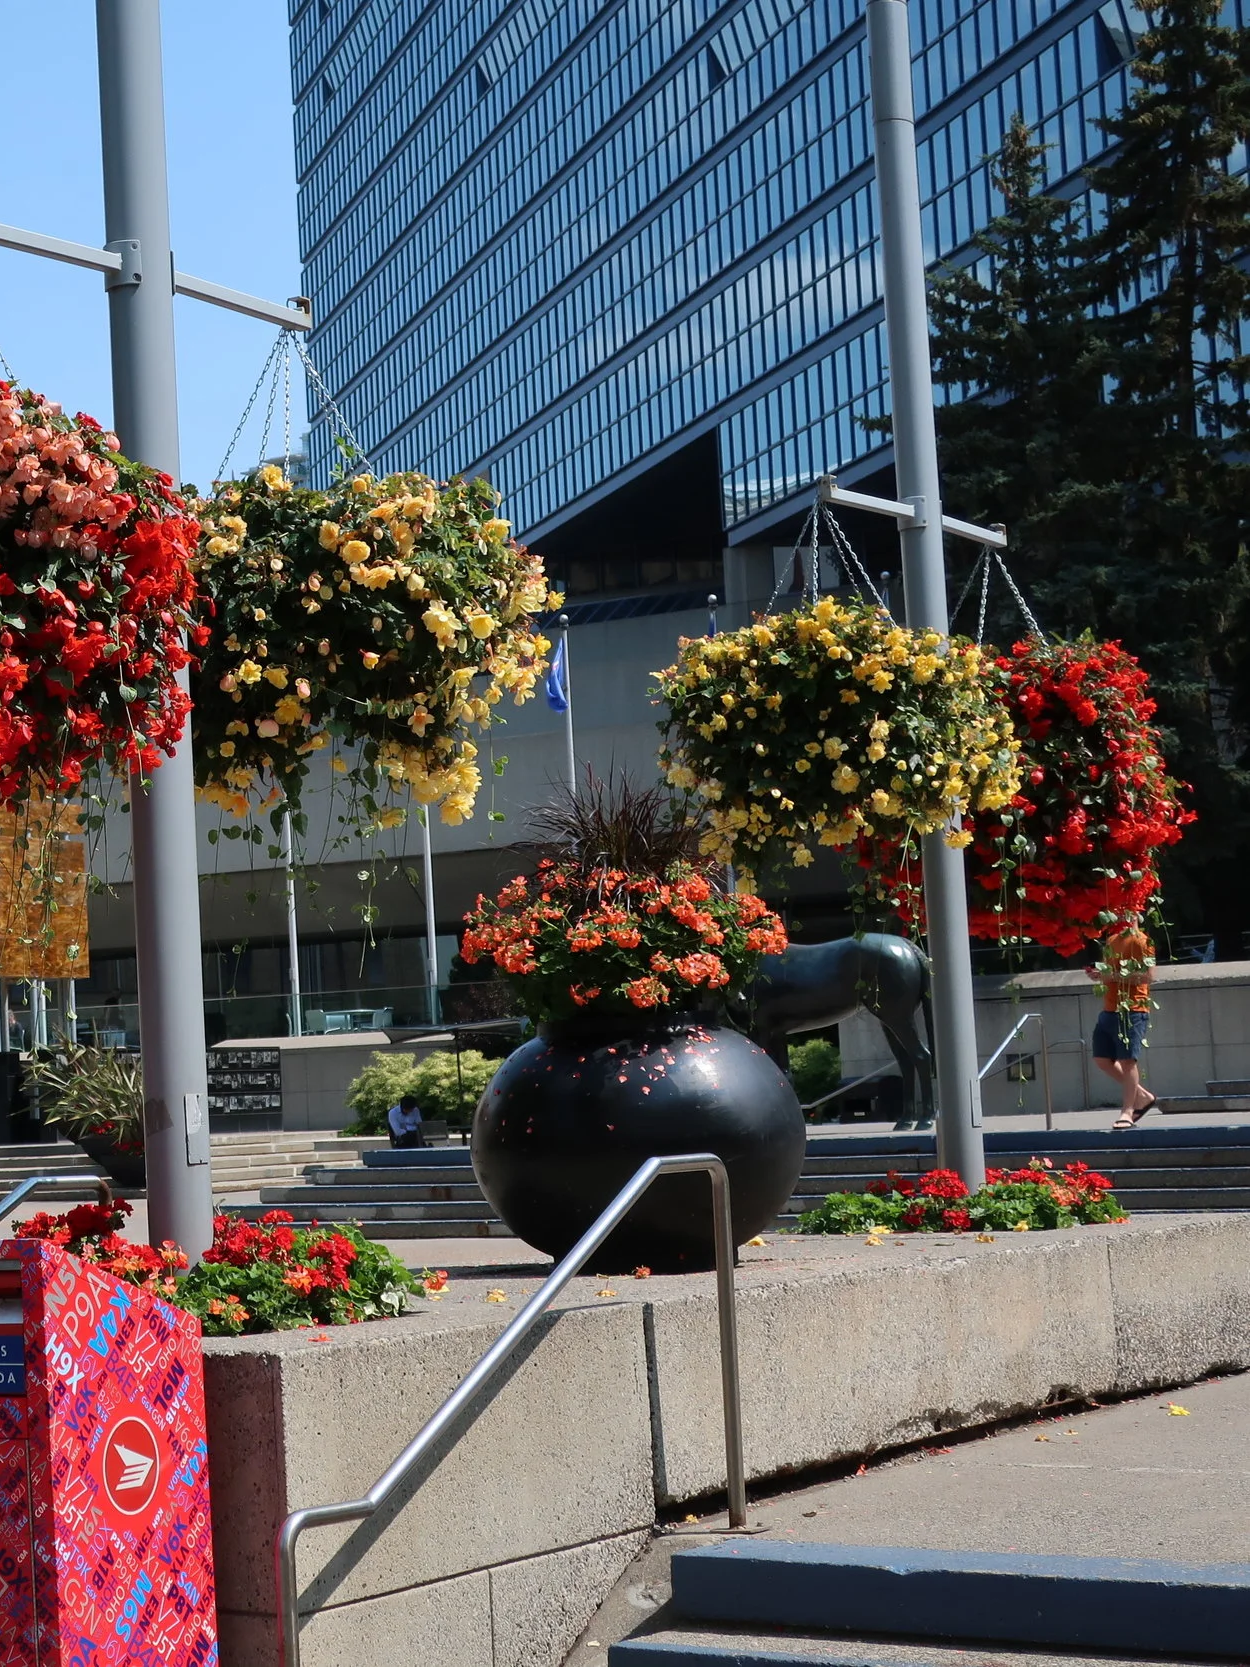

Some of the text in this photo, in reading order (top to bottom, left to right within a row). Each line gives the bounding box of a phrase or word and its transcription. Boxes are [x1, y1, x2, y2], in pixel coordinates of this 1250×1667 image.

[62, 1272, 110, 1349] P9A
[88, 1285, 131, 1357] K4A
[43, 1332, 85, 1396] H9X
[129, 1351, 152, 1380] J5T
[64, 1380, 97, 1432] V6K
[166, 1396, 181, 1425] A1B
[59, 1500, 84, 1532] J5T
[158, 1514, 188, 1565] V6K
[110, 1531, 126, 1554] P3Y
[64, 1578, 102, 1636] G3N
[115, 1569, 153, 1643] M6S
[152, 1631, 176, 1661] J5T
